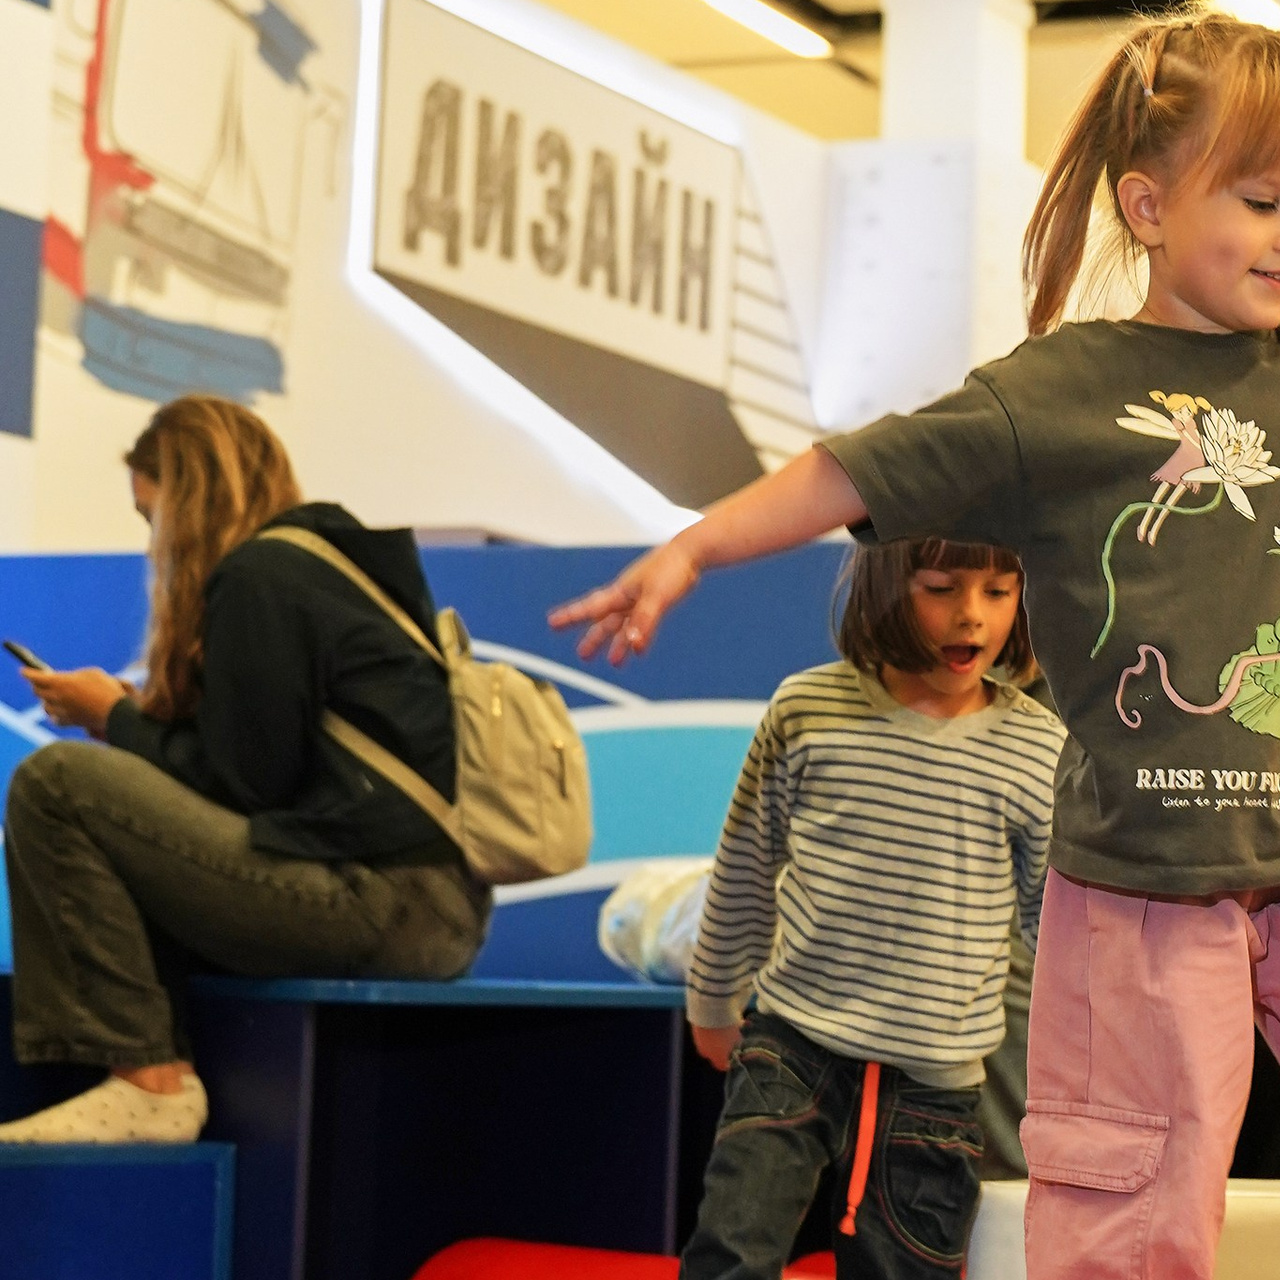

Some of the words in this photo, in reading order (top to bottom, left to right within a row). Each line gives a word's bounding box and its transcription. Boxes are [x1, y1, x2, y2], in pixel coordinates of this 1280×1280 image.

[402, 77, 717, 334] ДИЗАЙН
[1136, 768, 1205, 791] RAISE
[1211, 769, 1258, 792] YOU
[1194, 795, 1211, 807] to
